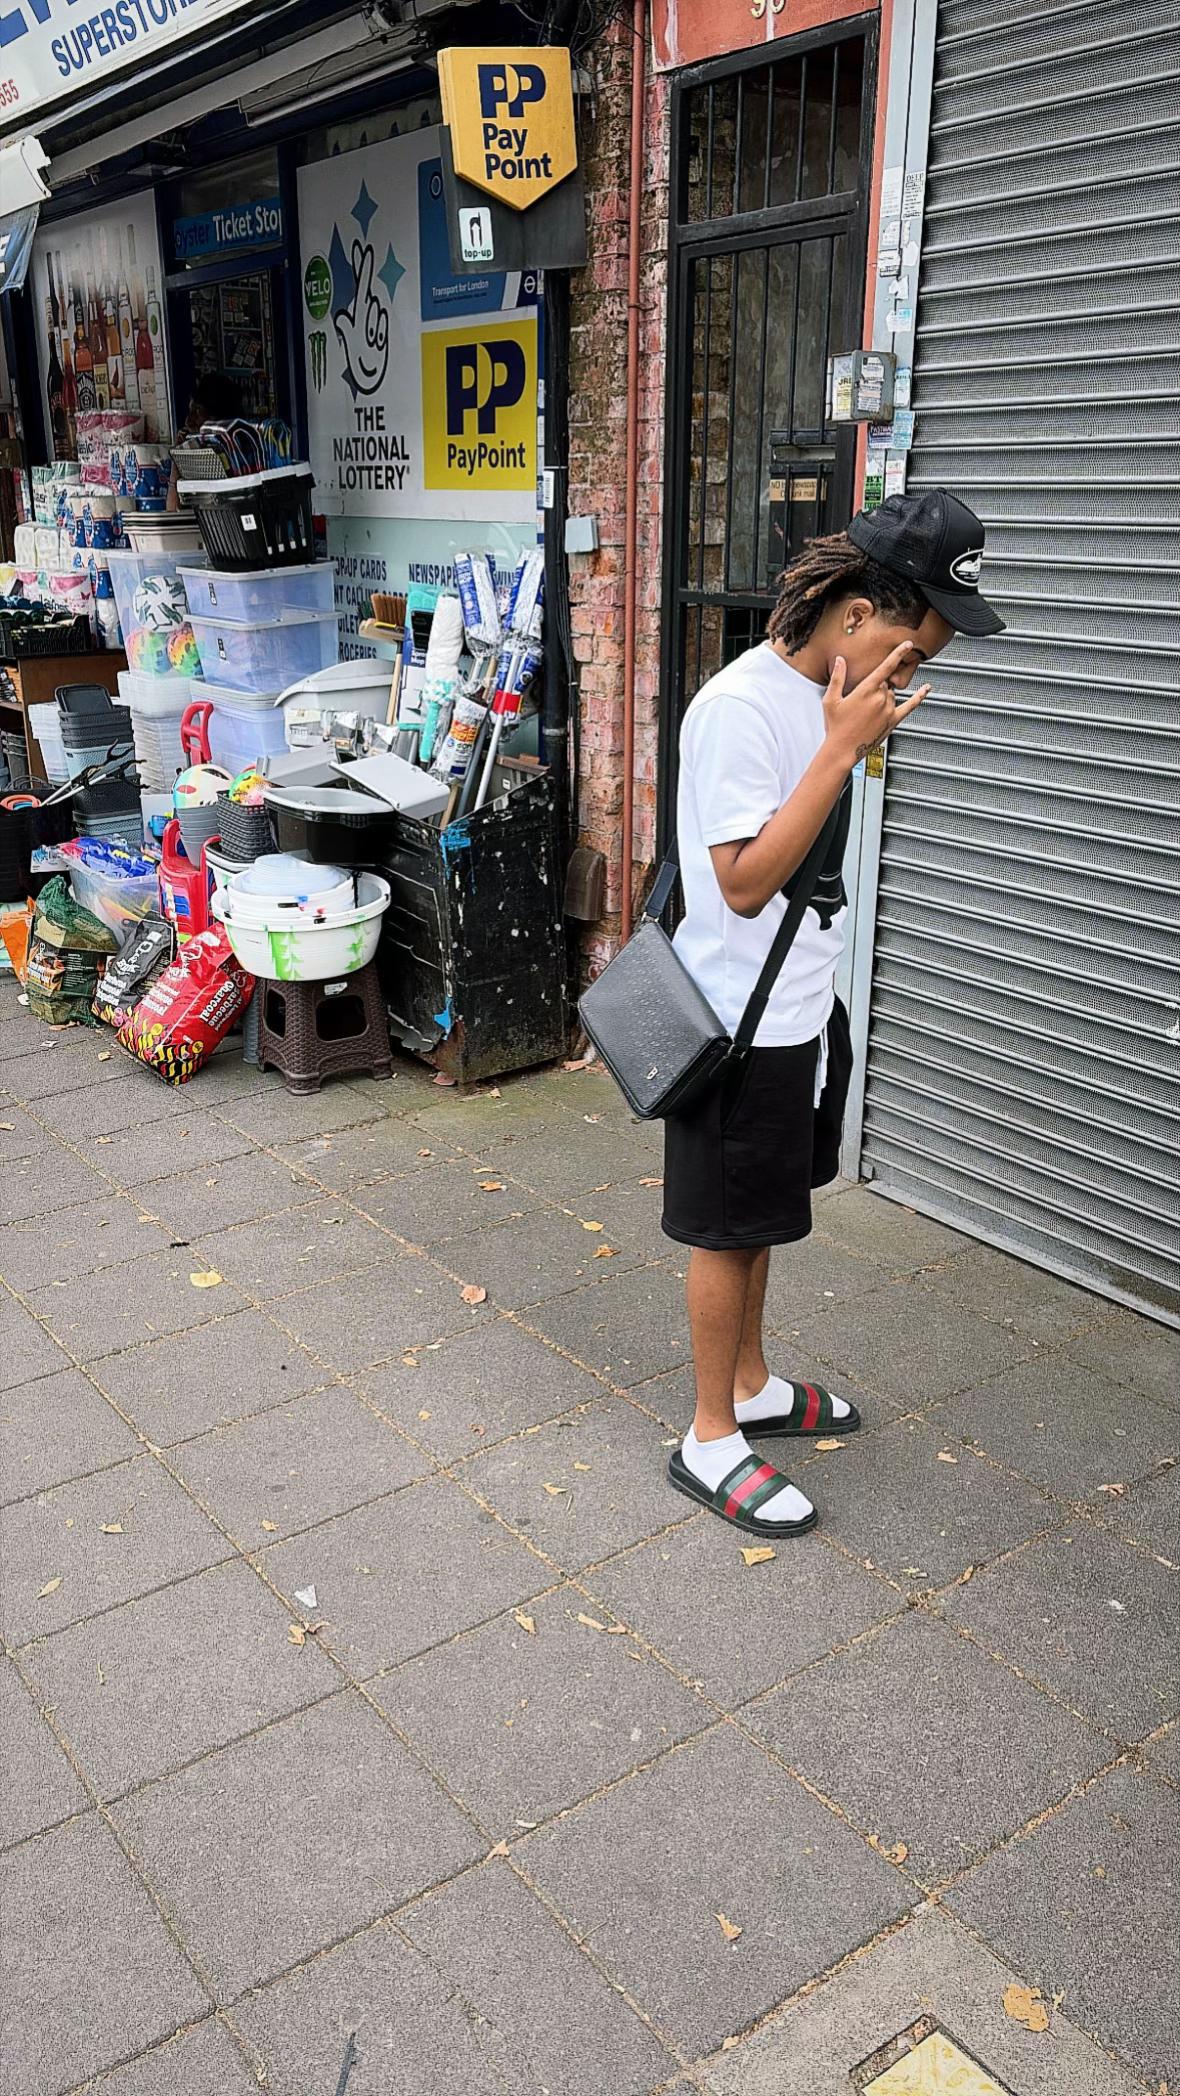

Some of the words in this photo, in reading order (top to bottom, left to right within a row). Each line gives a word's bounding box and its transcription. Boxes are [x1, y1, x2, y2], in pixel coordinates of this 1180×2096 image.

[482, 123, 528, 156] Pay
[485, 153, 552, 180] Point
[212, 211, 253, 242] Ticket
[464, 249, 492, 258] top-up
[304, 278, 330, 297] VELO
[432, 283, 458, 296] Transport
[459, 282, 467, 291] for
[468, 280, 489, 290] London
[354, 406, 385, 431] THE
[333, 435, 410, 461] NATIONAL
[447, 441, 526, 475] PayPoint
[338, 466, 406, 490] LOTTERY
[331, 556, 358, 577] OP-UP
[360, 560, 387, 581] CARDS
[408, 563, 458, 588] NEWSPAPE
[338, 641, 377, 662] ROCERIES
[200, 980, 235, 1022] Charcoal
